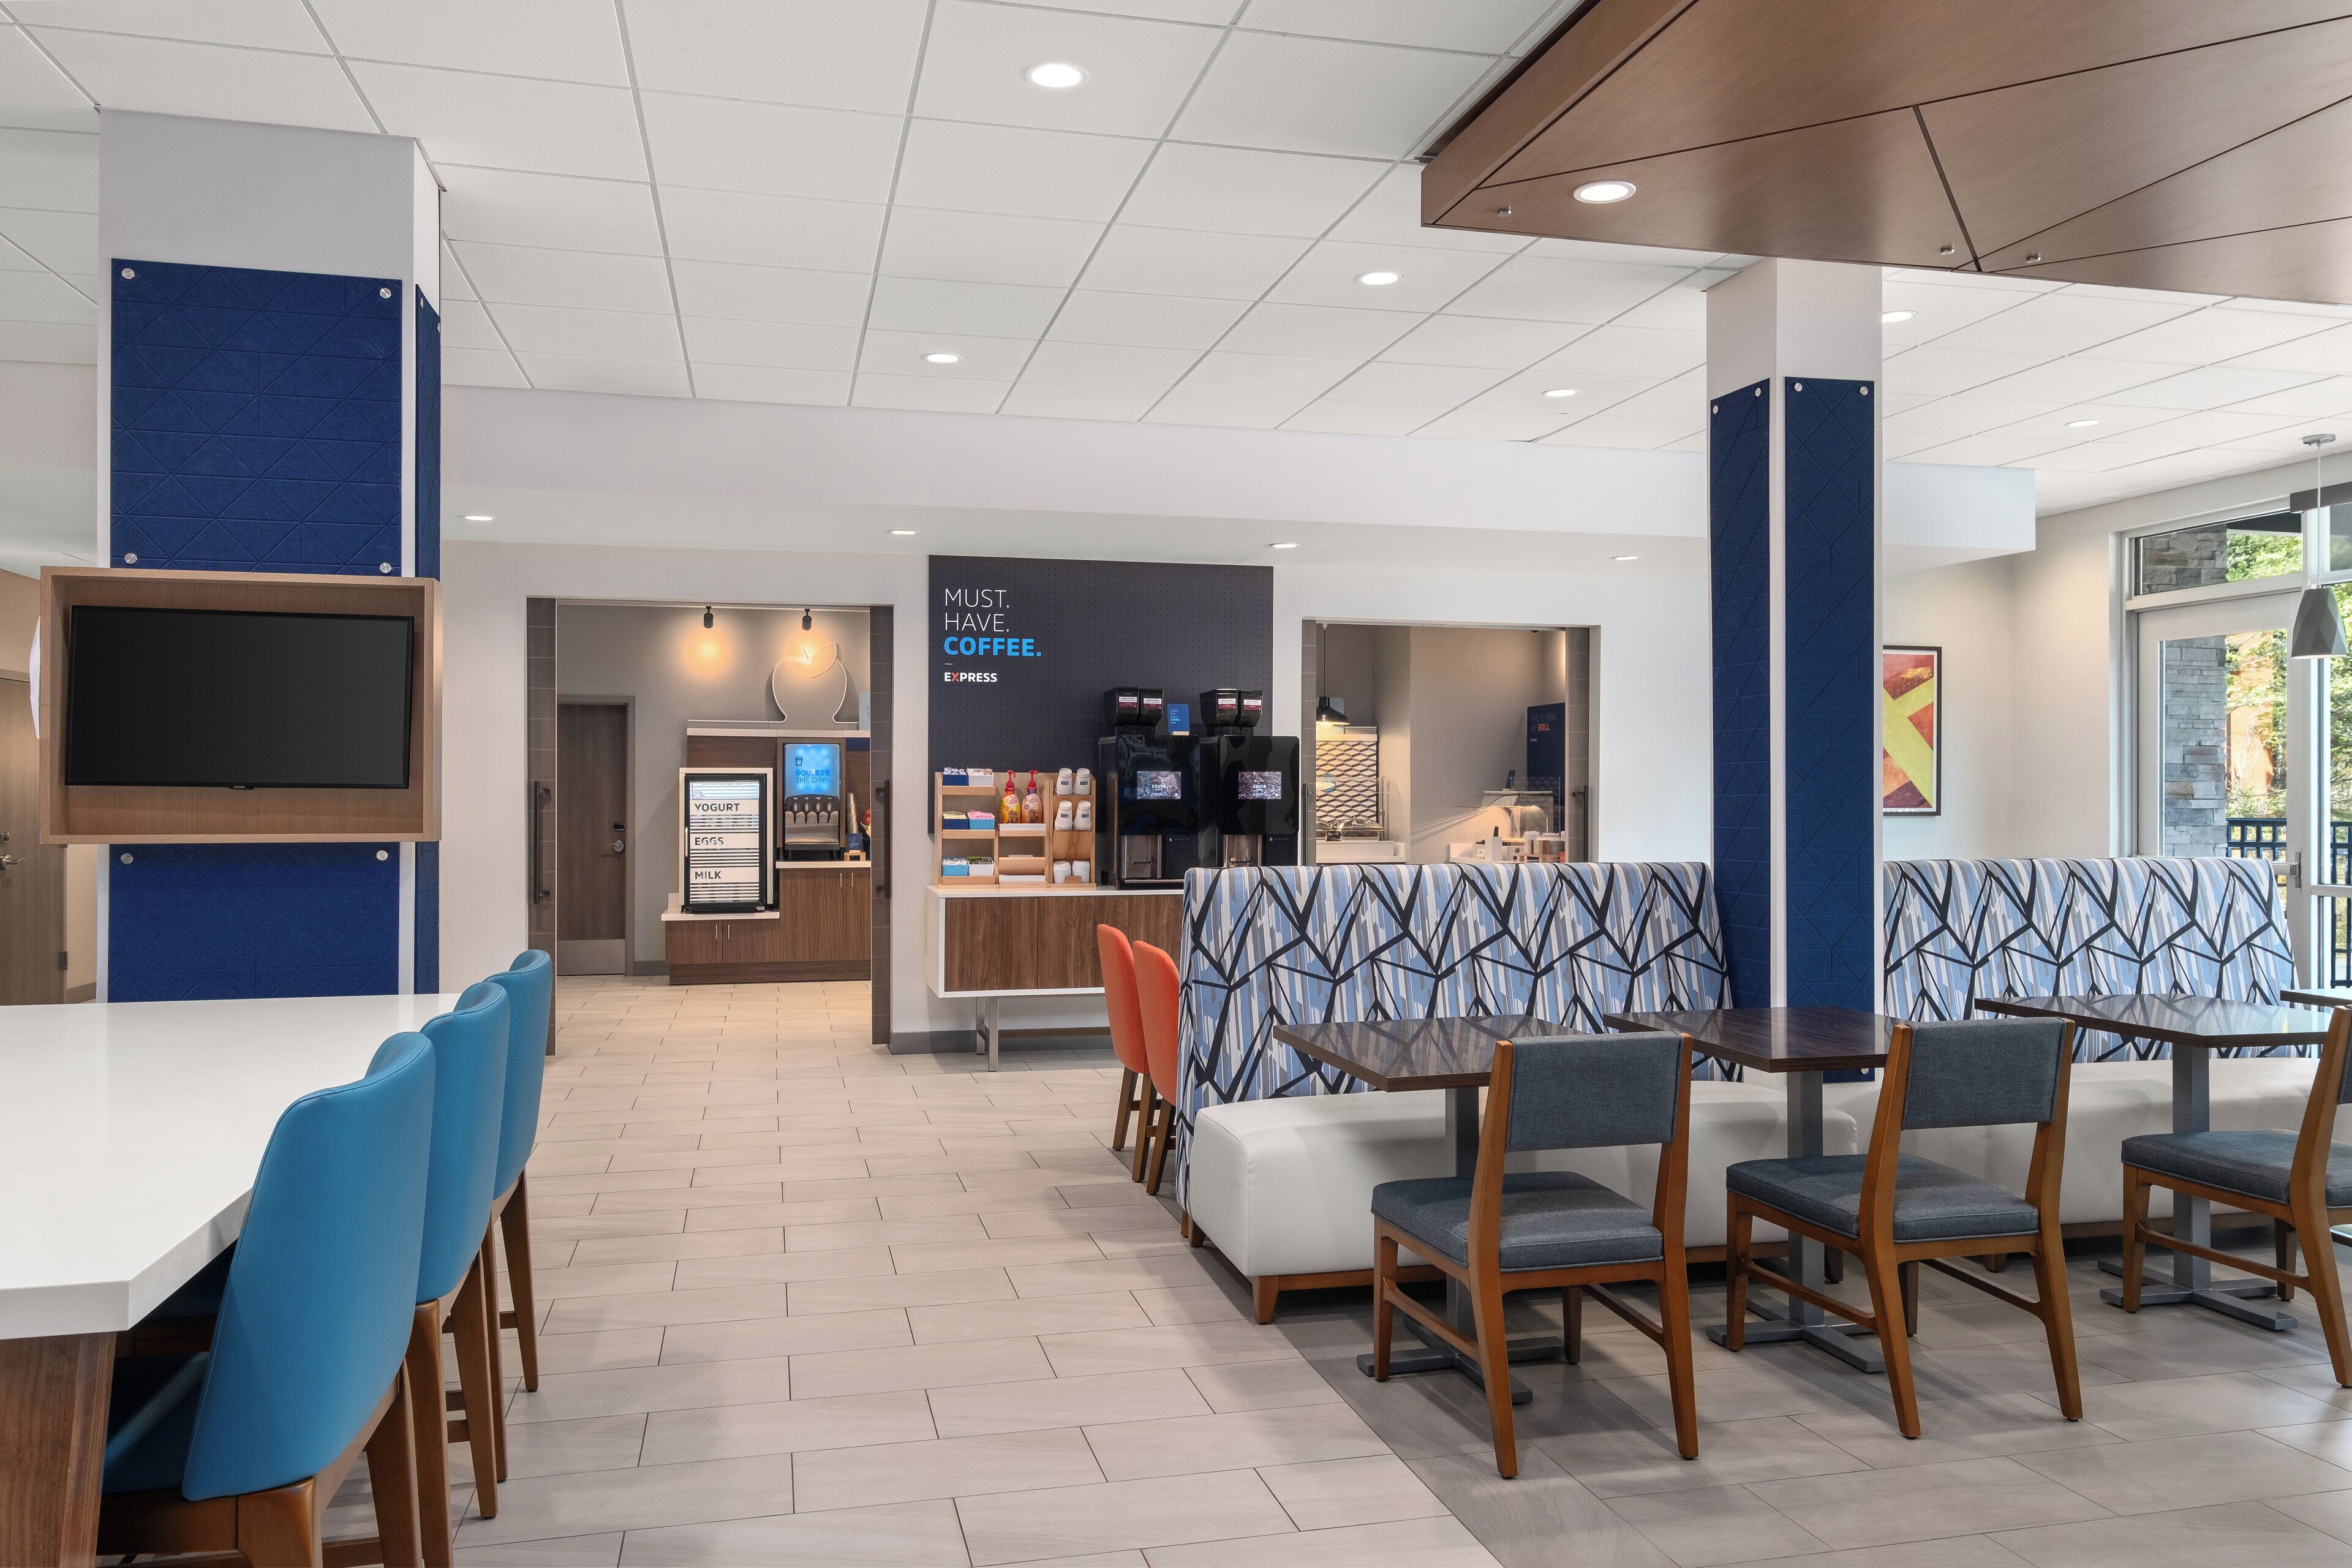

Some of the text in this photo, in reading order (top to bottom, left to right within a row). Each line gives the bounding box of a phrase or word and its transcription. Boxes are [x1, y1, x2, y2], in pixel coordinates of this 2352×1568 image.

[945, 588, 1009, 608] MUST.
[945, 612, 1009, 632] HAVE.
[944, 636, 1041, 657] COFFEE.
[944, 672, 998, 683] EXPRESS
[694, 803, 740, 812] YOGURT
[695, 837, 724, 845] EGGS
[695, 871, 722, 880] MILK
